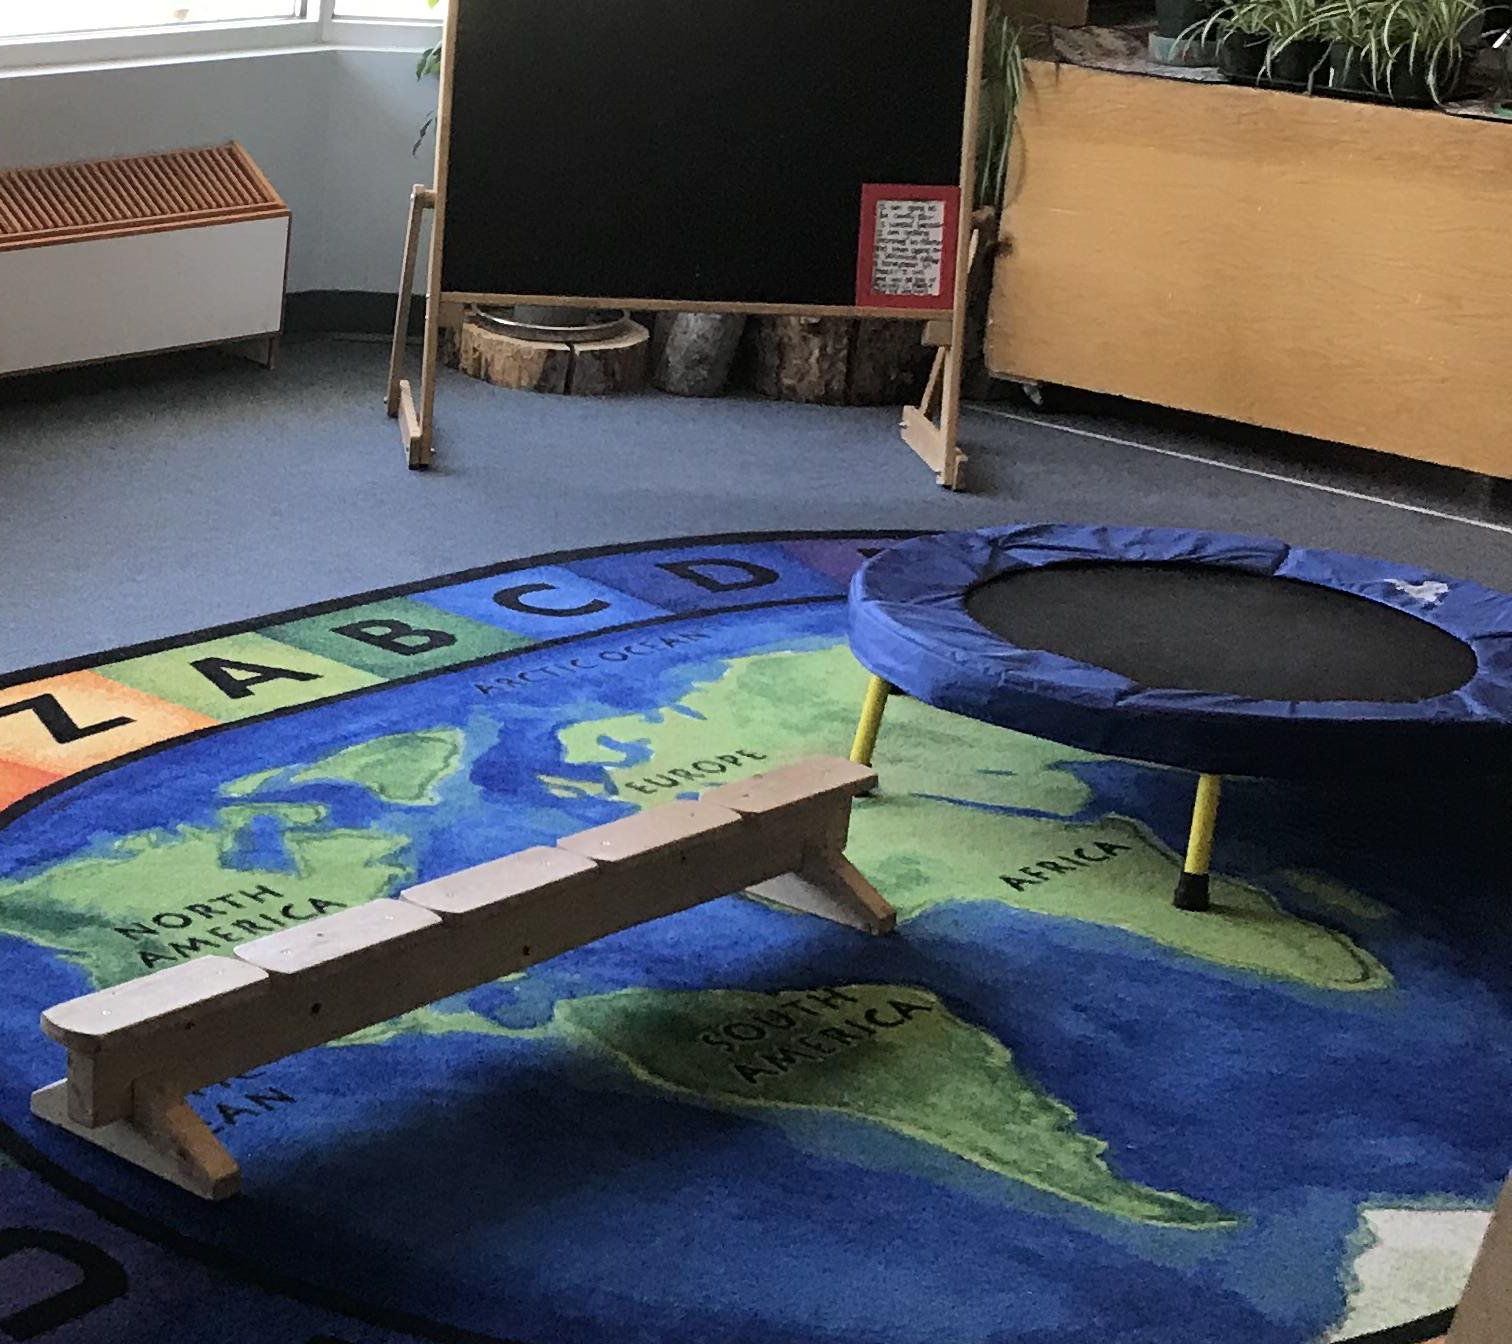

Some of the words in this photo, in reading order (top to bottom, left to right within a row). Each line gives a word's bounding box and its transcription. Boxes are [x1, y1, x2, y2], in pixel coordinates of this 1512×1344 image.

[189, 656, 324, 697] A
[330, 618, 457, 655] B
[493, 583, 610, 616] C
[656, 558, 780, 593] D
[474, 658, 598, 695] ARCTIC
[599, 633, 712, 662] OCEAN
[625, 749, 767, 794] EUROPE
[999, 841, 1132, 892] AFRICA
[114, 884, 284, 940] NORTH
[138, 897, 348, 969] AMERICA
[701, 988, 859, 1052] SOUTH
[734, 1000, 933, 1084] AMERICA
